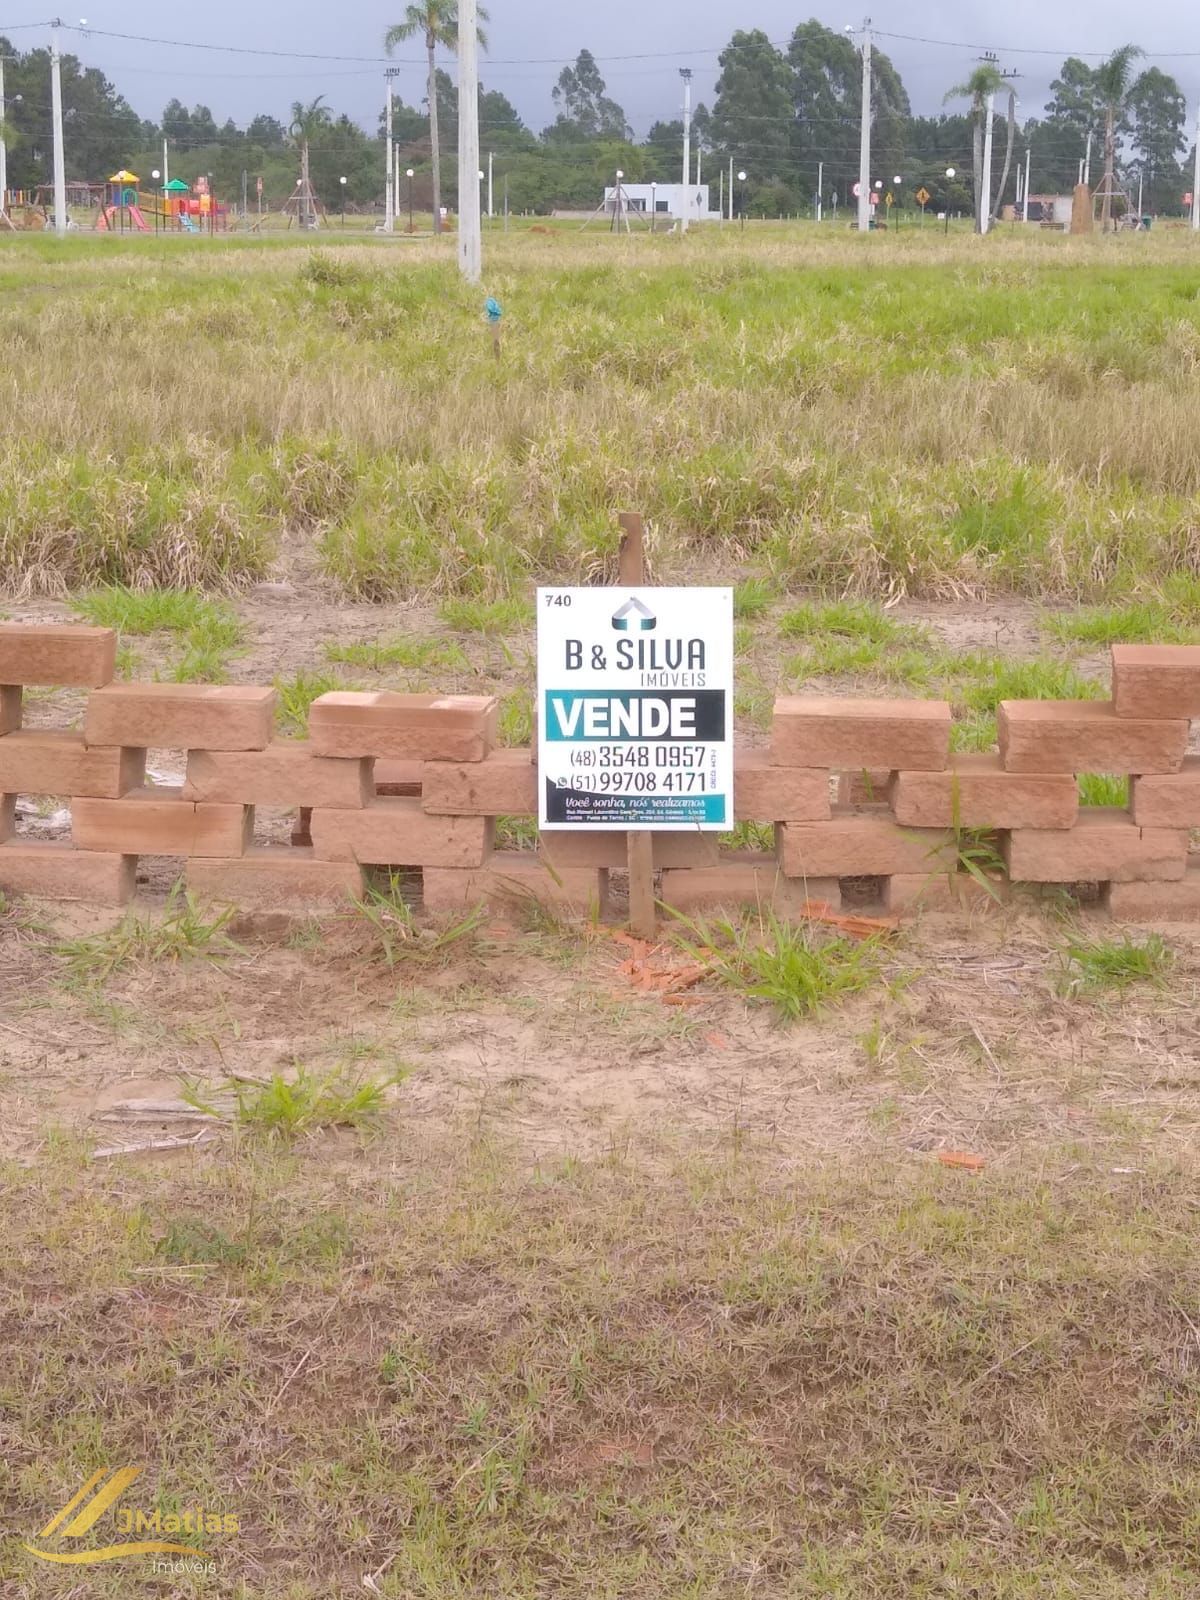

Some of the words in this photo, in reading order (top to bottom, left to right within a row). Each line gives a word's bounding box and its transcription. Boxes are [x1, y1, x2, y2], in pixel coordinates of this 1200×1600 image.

[545, 595, 571, 607] 740
[566, 639, 583, 670] B
[591, 645, 607, 670] &
[617, 638, 706, 670] SILVA
[641, 671, 706, 687] IMÓVEIS
[552, 698, 696, 737] VENDE
[570, 750, 596, 767] (48)
[600, 746, 649, 767] 3548
[656, 746, 705, 767] 0957
[570, 775, 596, 792] (51)
[600, 772, 657, 791] 99708
[663, 772, 706, 791] 4171
[566, 797, 590, 807] Você
[593, 798, 626, 808] sonha,
[630, 798, 648, 807] nós
[652, 798, 705, 807] realizamos
